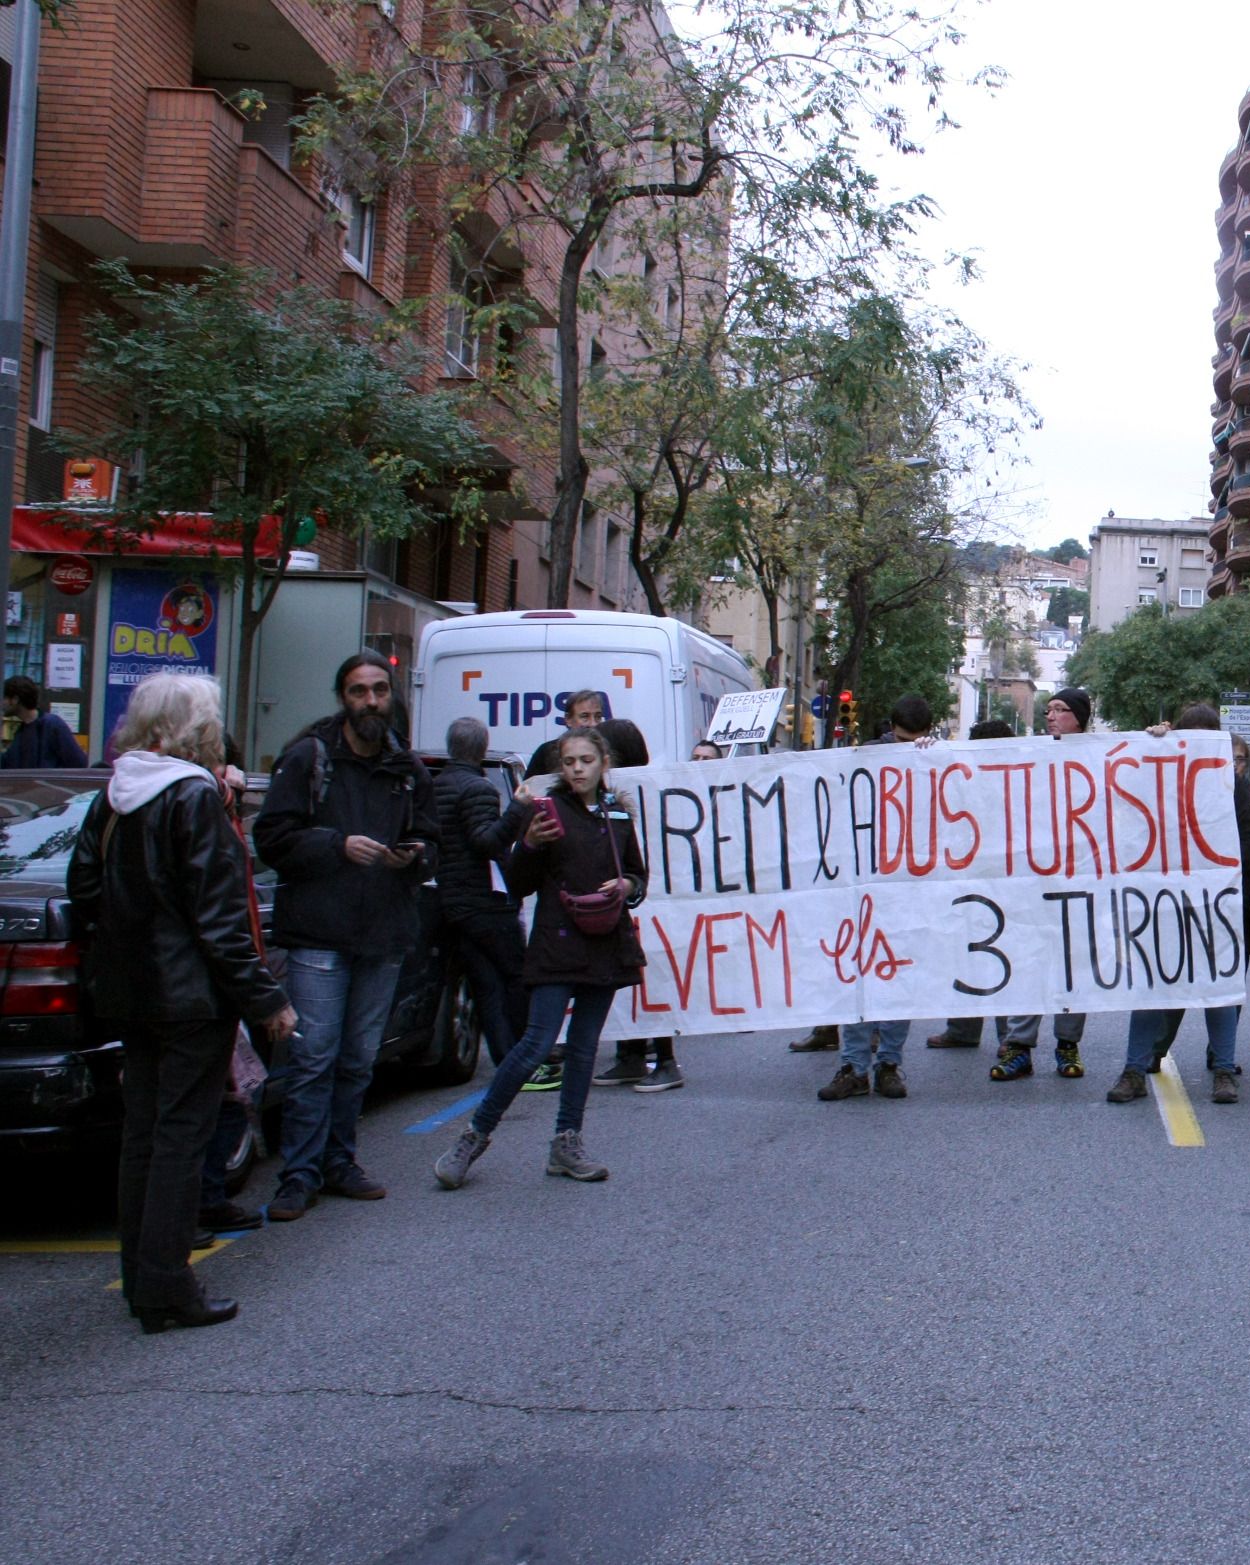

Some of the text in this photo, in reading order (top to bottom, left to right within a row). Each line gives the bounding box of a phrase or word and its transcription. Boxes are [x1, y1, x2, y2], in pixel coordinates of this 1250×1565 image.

[820, 893, 913, 985] els
[951, 893, 1013, 996] 3
[1042, 886, 1242, 993] TURONS
